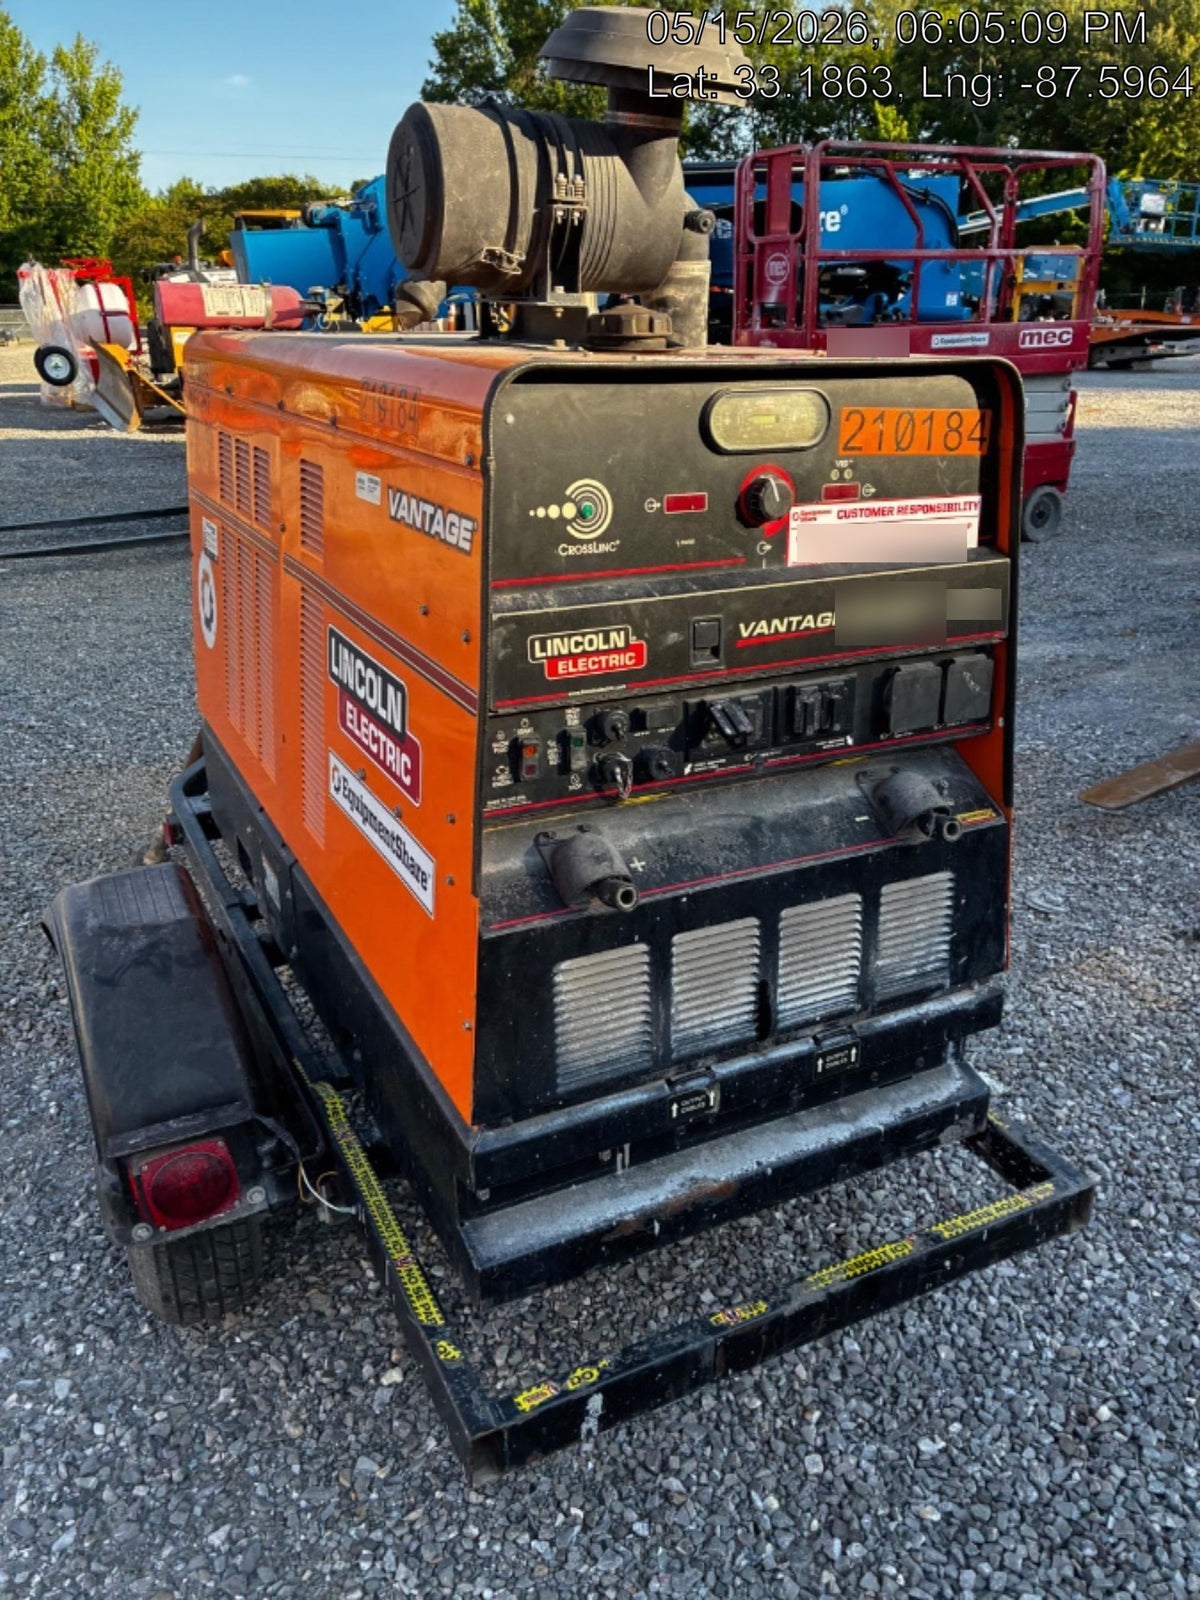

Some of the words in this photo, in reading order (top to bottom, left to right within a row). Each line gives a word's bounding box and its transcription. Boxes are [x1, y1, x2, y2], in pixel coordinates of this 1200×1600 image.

[1020, 330, 1071, 345] mec
[842, 409, 988, 452] 210184
[388, 487, 473, 552] VANTAGE
[837, 505, 894, 520] CUSTOMER
[896, 501, 980, 516] RESPONSIBILITY
[738, 611, 836, 637] VANTAG
[534, 630, 625, 658] LINCOLN
[557, 651, 636, 675] ELECTRIC
[331, 637, 402, 733] LINCOLN
[346, 700, 411, 786] ELECTRIC
[342, 776, 429, 891] EquipmentShare
